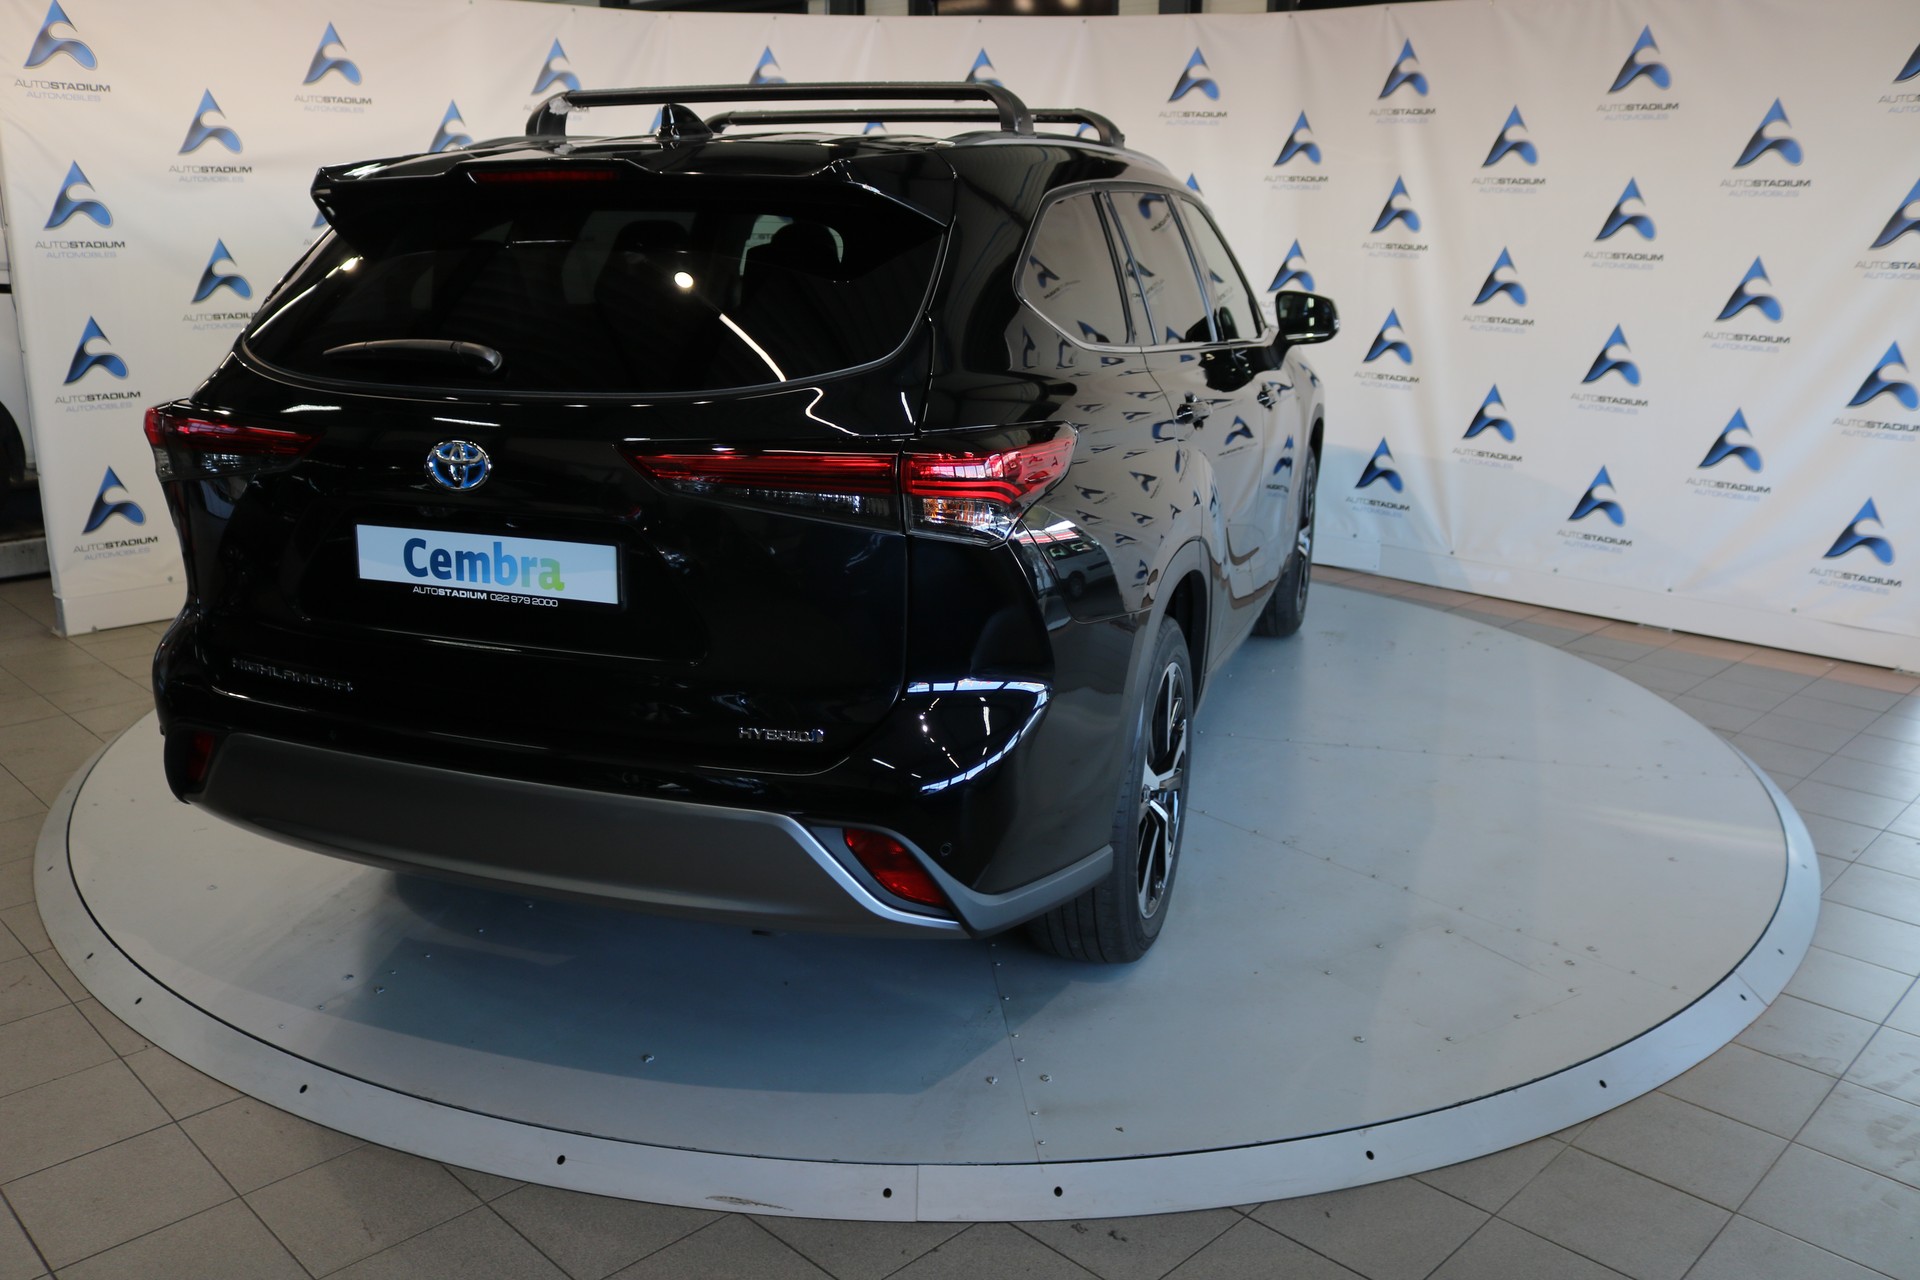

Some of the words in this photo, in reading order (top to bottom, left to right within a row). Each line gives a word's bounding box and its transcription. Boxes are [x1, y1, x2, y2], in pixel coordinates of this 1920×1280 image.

[14, 79, 111, 92] AUTOSTADIUM
[26, 90, 101, 101] AUTOMOBILES
[294, 94, 372, 105] AUTOSTADIUM
[1369, 108, 1436, 116] AUTOSTADIUM
[1596, 102, 1679, 111] AUTOSTADIUM
[169, 165, 252, 174] AUTOSTADIUM
[1471, 177, 1546, 185] AUTOSTADIUM
[1720, 179, 1811, 188] AUTOSTADIUM
[35, 240, 125, 249] AUTOSTADIUM
[1362, 242, 1428, 251] AUTOSTADIUM
[1584, 251, 1664, 261] AUTOSTADIUM
[1462, 315, 1534, 326] AUTOSTADIUM
[1703, 331, 1790, 344] AUTOSTADIUM
[1354, 371, 1420, 383] AUTOSTADIUM
[55, 391, 141, 404] AUTOSTADIUM
[1571, 392, 1648, 407] AUTOSTADIUM
[1452, 448, 1522, 462] AUTOSTADIUM
[1686, 477, 1771, 494] AUTOSTADIUM
[1346, 496, 1410, 511] AUTOSTADIUM
[73, 536, 158, 553] AUTOSTADIUM
[1556, 529, 1632, 547] AUTOSTADIUM
[403, 537, 565, 592] Cembra
[1809, 567, 1902, 588] AUTOSTADIUM
[412, 585, 487, 601] AUTOSTADIUM
[490, 593, 509, 602] 022
[510, 595, 531, 605] 979
[532, 597, 559, 608] 2000
[739, 727, 810, 742] HYBRID
